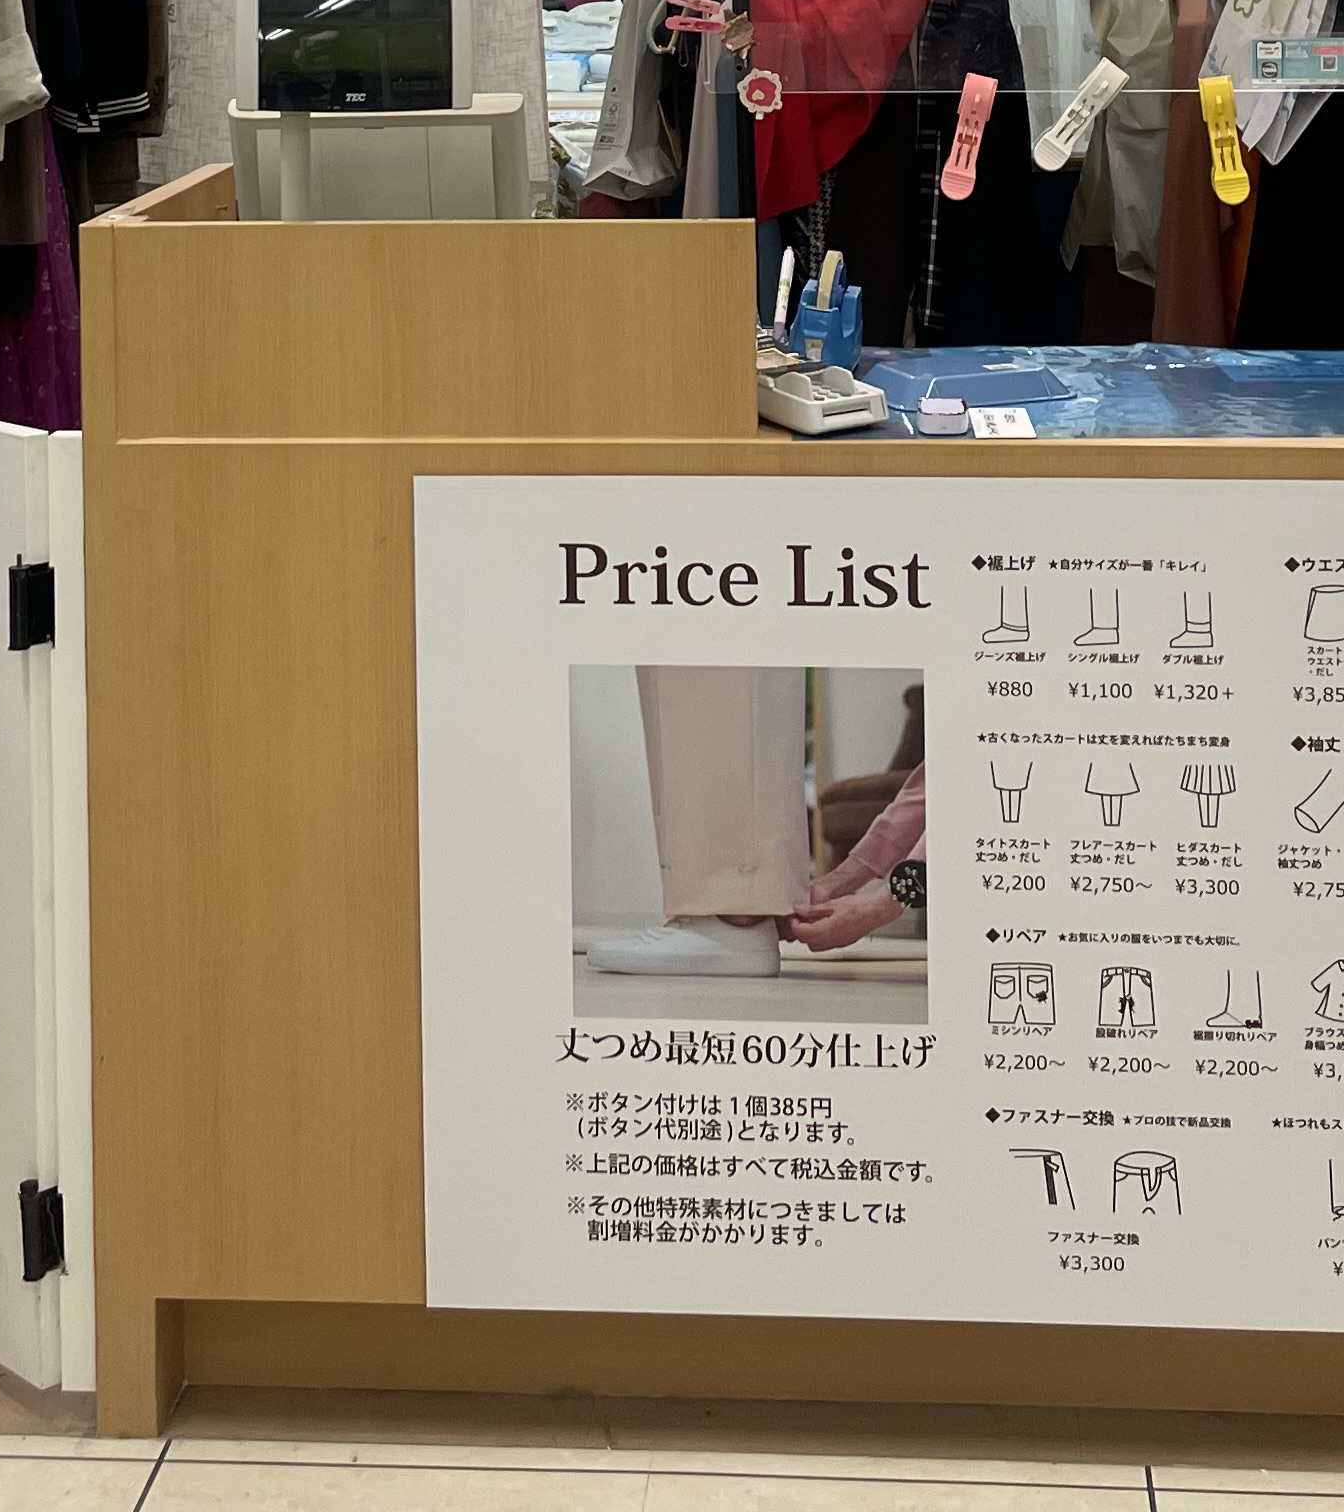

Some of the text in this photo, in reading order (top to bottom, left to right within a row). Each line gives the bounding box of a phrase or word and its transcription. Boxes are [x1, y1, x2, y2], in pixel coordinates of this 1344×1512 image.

[346, 93, 366, 101] TEC
[988, 555, 1036, 571] 裾上げ
[559, 543, 931, 608] Price List
[1307, 646, 1342, 654] スカート
[975, 652, 1223, 665] ジーンズ裾上げ シングル裾上げ ダブル裾上げ
[988, 681, 1033, 697] ¥880
[1069, 683, 1133, 701] ¥1,100
[1308, 737, 1341, 753] 袖丈
[976, 839, 1051, 849] タイトスカート
[1071, 840, 1157, 851] フレアースカート
[1177, 843, 1241, 853] ヒダスカート
[1278, 859, 1322, 870] 袖丈つめ
[982, 875, 1045, 893] ¥2,200
[1175, 878, 1239, 897] ¥3,300
[1003, 929, 1046, 943] リペア
[556, 1028, 937, 1069] 丈つめ最短60分仕上げ
[1002, 1110, 1115, 1126] ファスナー交換
[566, 1153, 933, 1183] ※上記の価格はすべて税込金額です。
[568, 1195, 906, 1224] ※その他特殊素材につきましては
[588, 1220, 823, 1247] 割増料金がかかります。
[1048, 1232, 1139, 1246] ファスナー交換
[1060, 1255, 1125, 1273] ¥3,300
